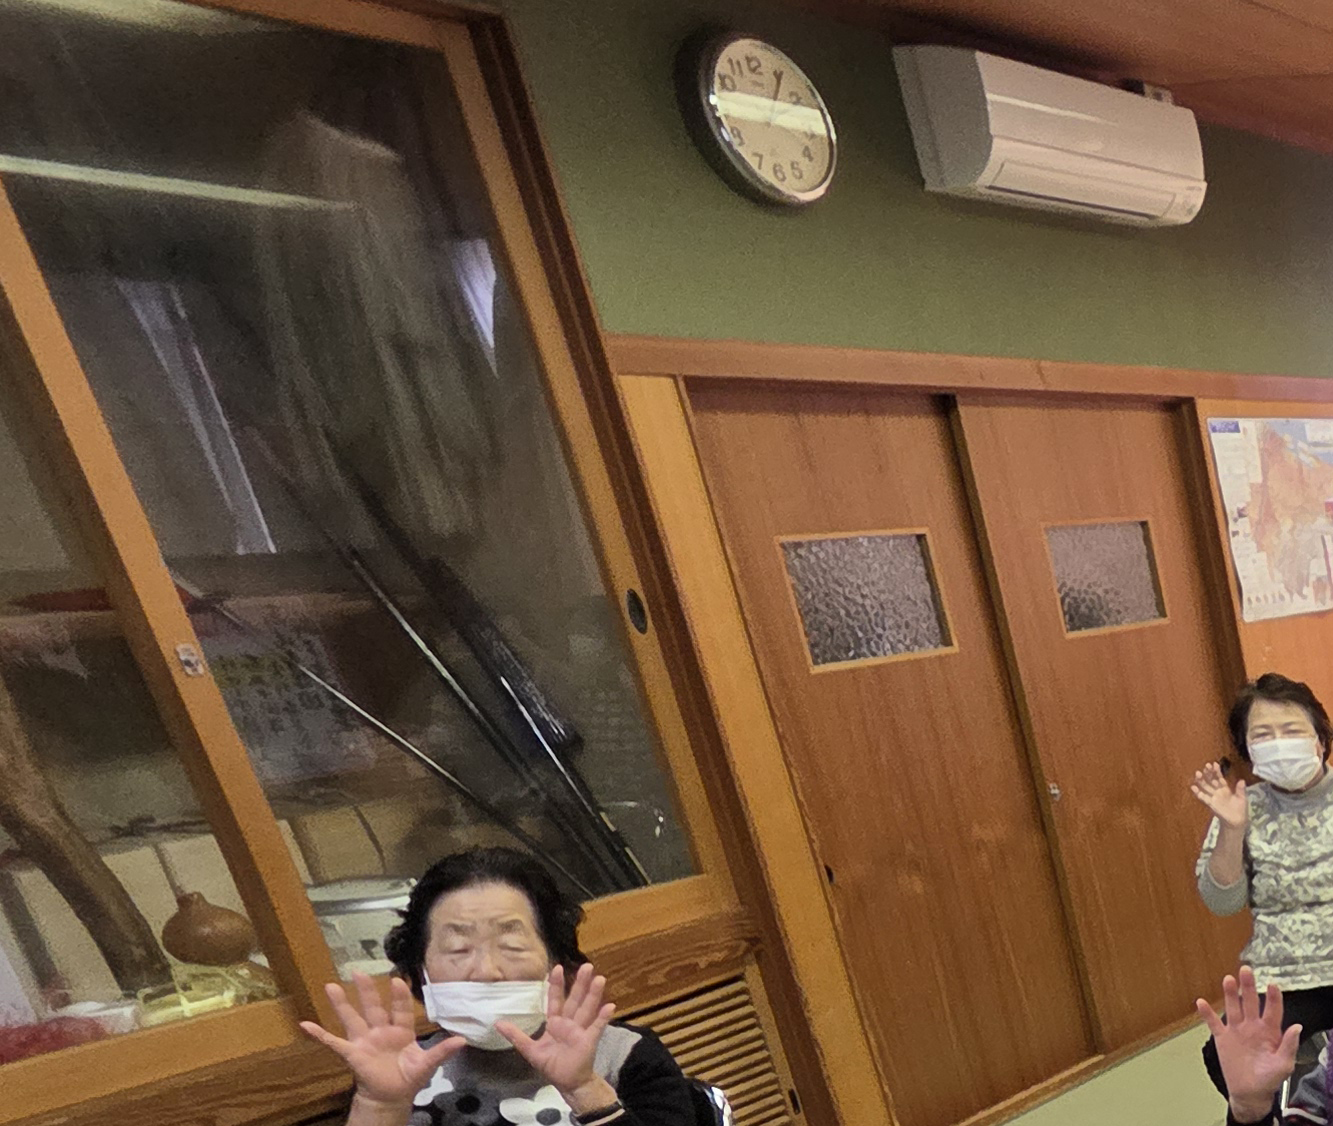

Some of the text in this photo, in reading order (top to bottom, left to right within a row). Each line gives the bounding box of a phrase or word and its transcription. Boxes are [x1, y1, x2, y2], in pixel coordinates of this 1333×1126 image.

[727, 57, 743, 78] 11
[745, 54, 763, 75] 12
[752, 151, 764, 169] 7
[802, 145, 814, 162] 4
[773, 163, 786, 182] 6
[790, 161, 803, 179] 5
